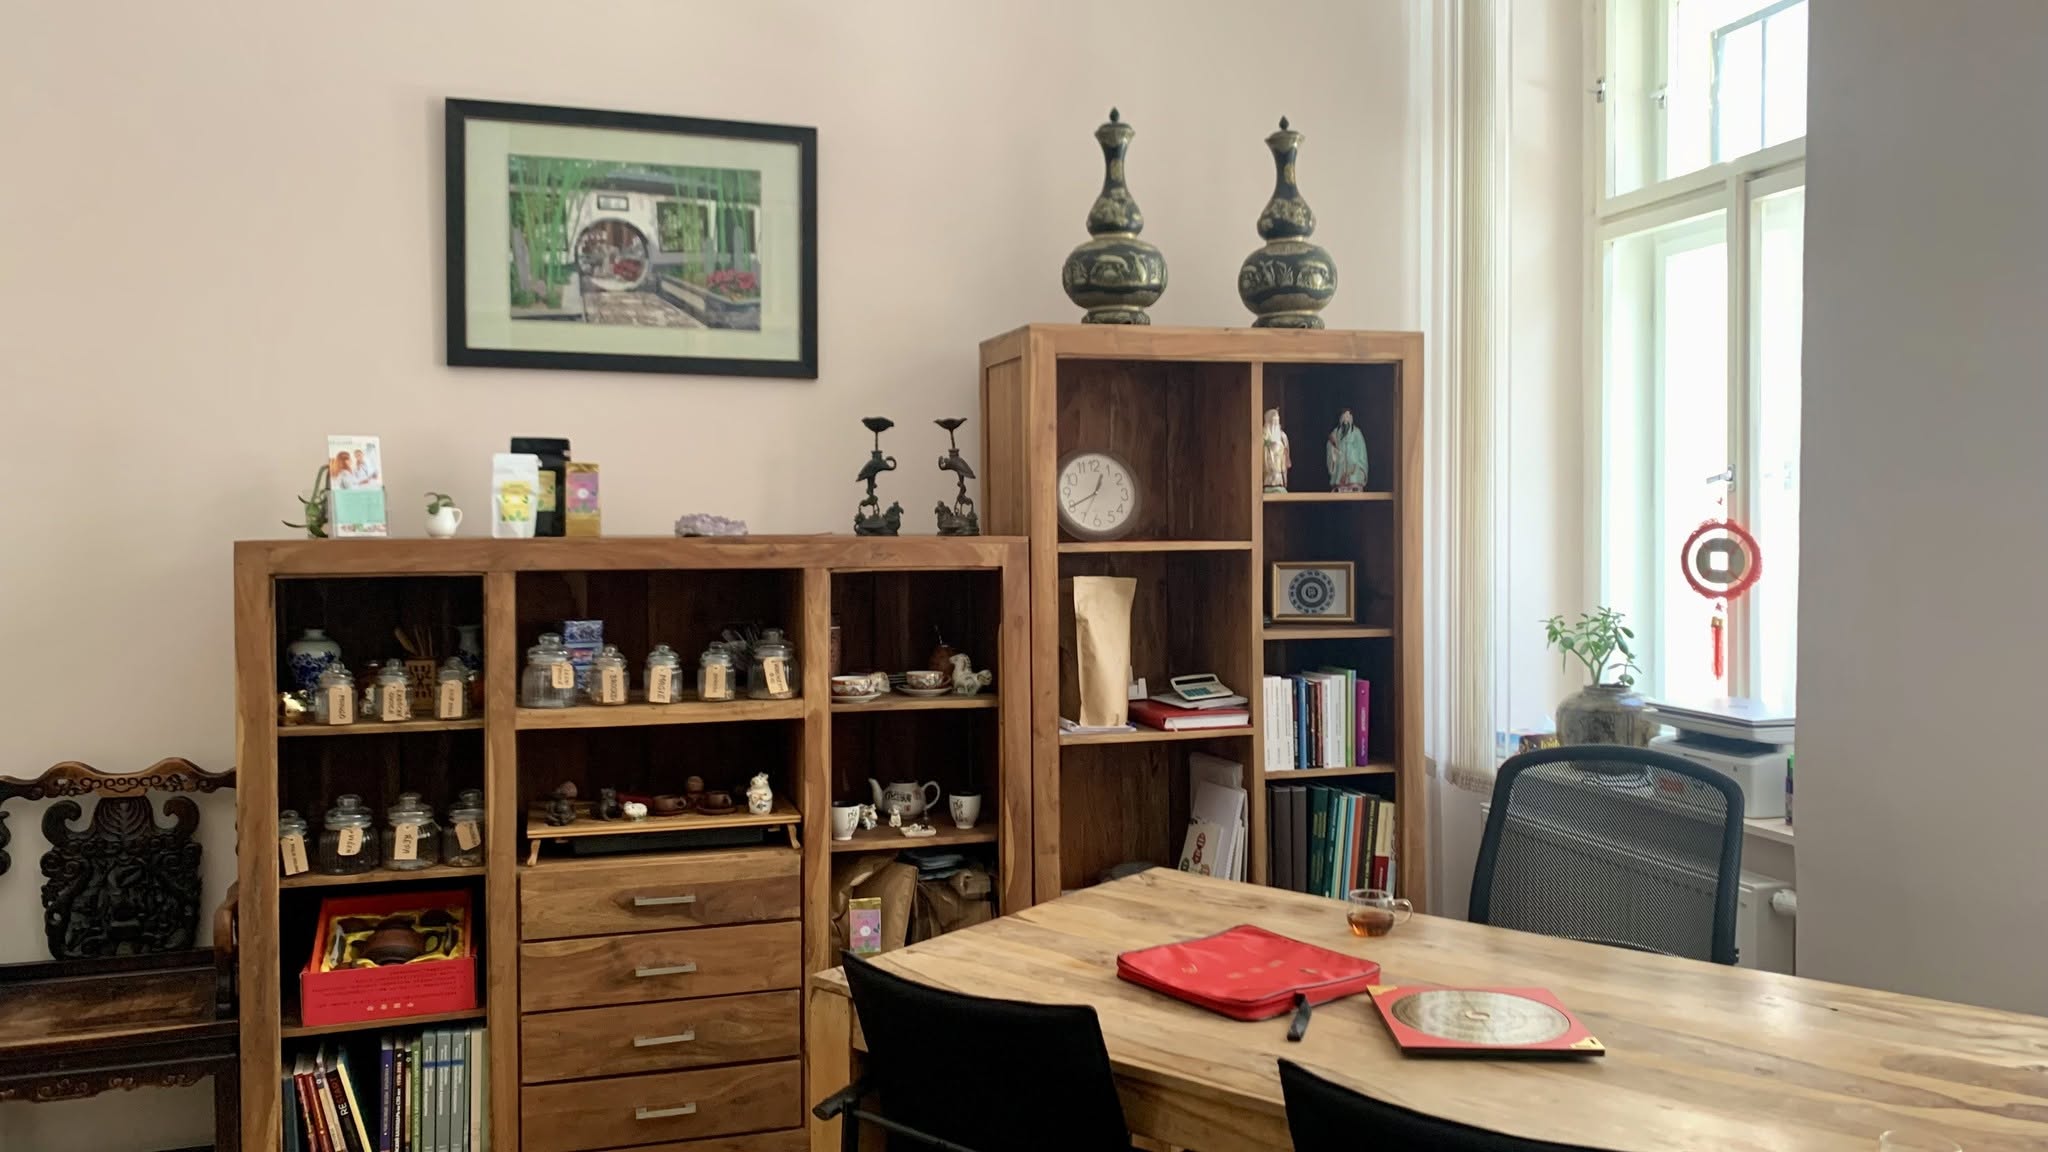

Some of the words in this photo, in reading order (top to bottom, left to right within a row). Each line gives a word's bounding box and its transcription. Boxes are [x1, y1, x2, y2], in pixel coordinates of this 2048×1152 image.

[1077, 461, 1086, 474] 11
[1088, 459, 1100, 473] 12
[1106, 464, 1111, 476] 1
[1065, 472, 1078, 486] 10
[1115, 473, 1123, 485] 2
[1063, 486, 1071, 498] 9
[1120, 488, 1129, 501] 3
[1068, 499, 1076, 514] 8
[1116, 503, 1124, 514] 4
[1081, 511, 1087, 523] 7
[1093, 514, 1102, 527] 6
[1108, 510, 1115, 523] 5
